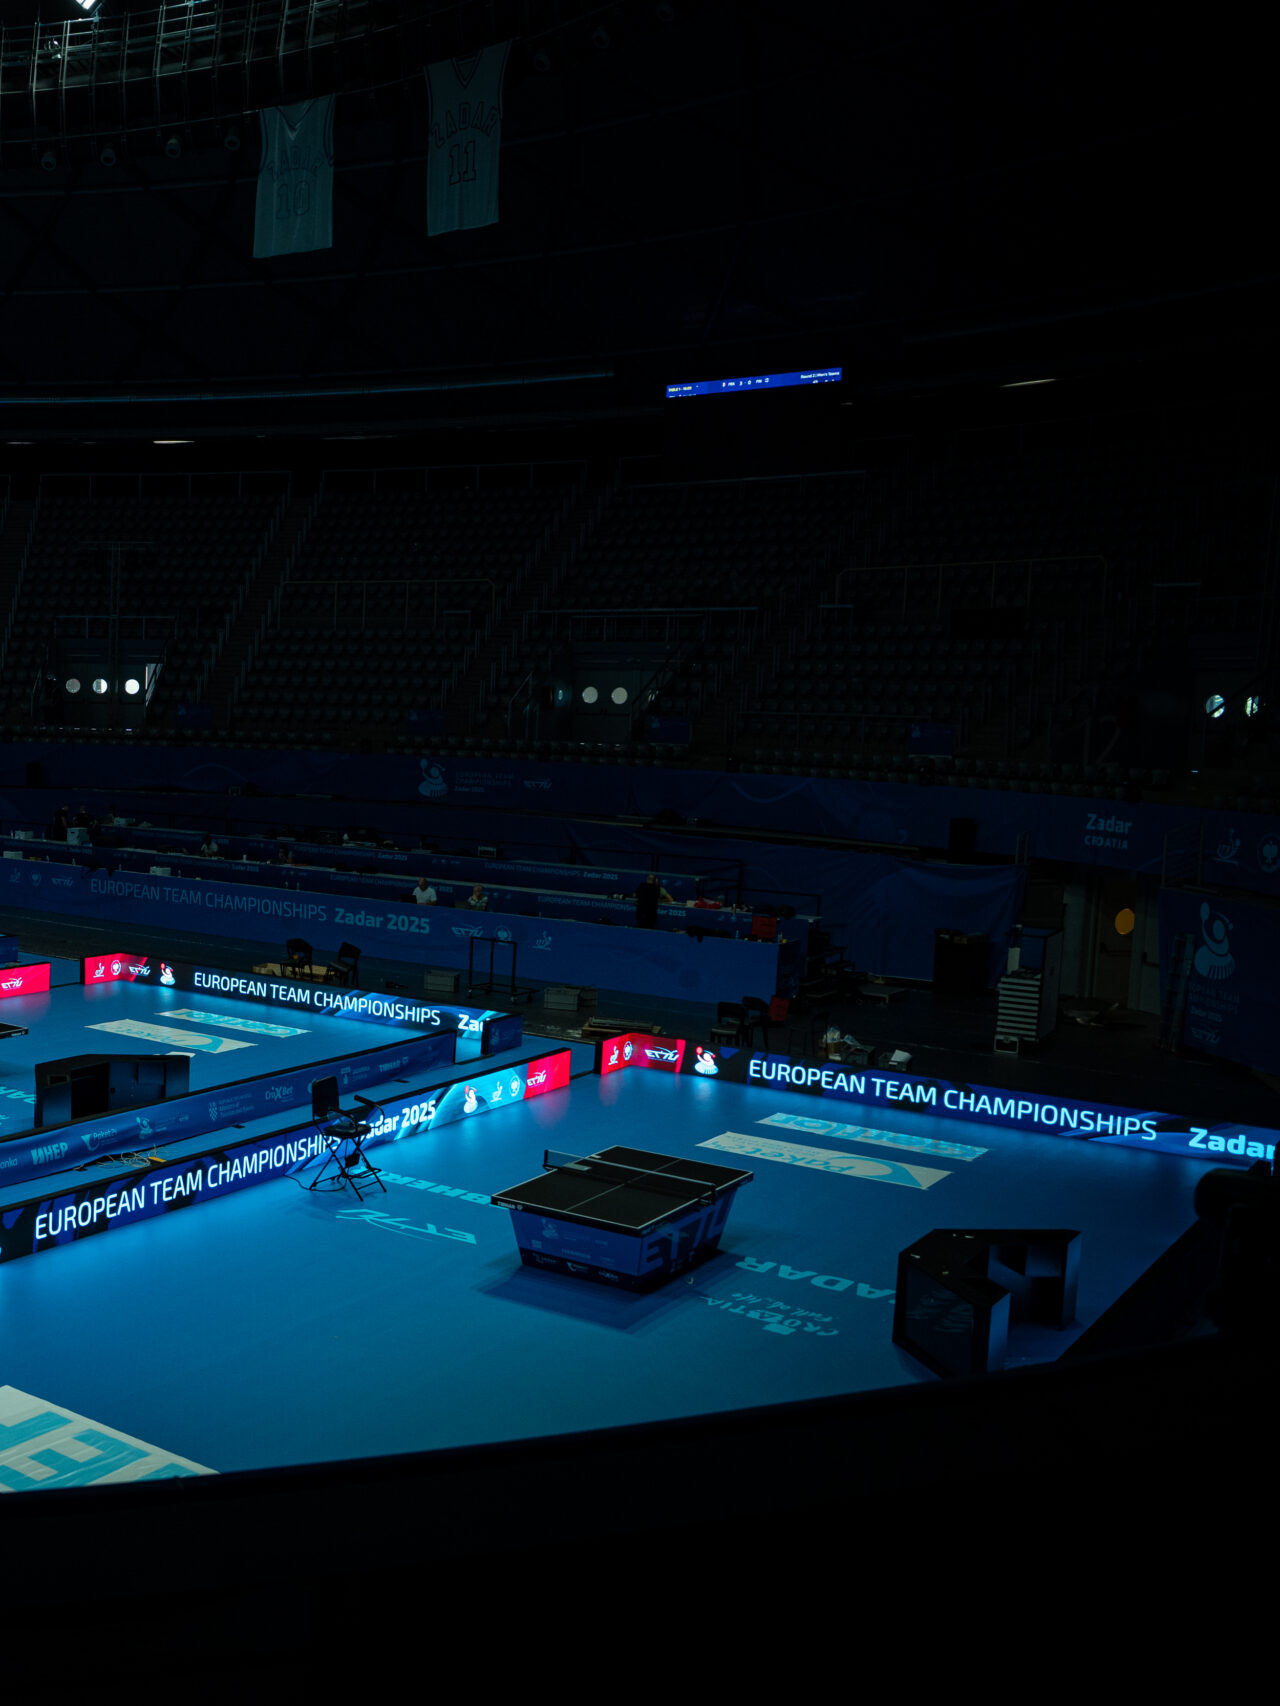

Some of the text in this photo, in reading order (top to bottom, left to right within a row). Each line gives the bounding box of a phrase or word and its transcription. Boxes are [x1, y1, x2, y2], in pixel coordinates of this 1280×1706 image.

[449, 141, 476, 185] 11
[1085, 813, 1133, 834] Zadar
[1084, 835, 1128, 850] CROATIA
[583, 871, 601, 880] Zadar
[603, 873, 618, 881] 2025
[91, 877, 430, 935] EUROPEAN TEAM CHAMPIONSHIPS Zadar 2025
[1, 977, 23, 990] ETTU
[129, 964, 151, 977] ETTU
[194, 972, 267, 998] EUROPEAN
[270, 984, 311, 1005] TEAM
[314, 990, 441, 1026] CHAMPIONSHIPS
[646, 1048, 680, 1063] ETTU
[526, 1069, 547, 1085] ETTU
[749, 1058, 1276, 1160] EUROPEAN TEAM CHAMPIONSHIPS Zadar
[43, 1142, 68, 1162] HEP
[769, 1115, 970, 1160] Gerflor
[35, 1184, 145, 1240] EUROPEAN
[150, 1168, 203, 1203] TEAM
[207, 1135, 340, 1185] CHAMPIONSHIPS
[402, 1100, 437, 1127] 2025
[735, 1256, 895, 1301] ADAR
[700, 1296, 839, 1337] CROATIA
